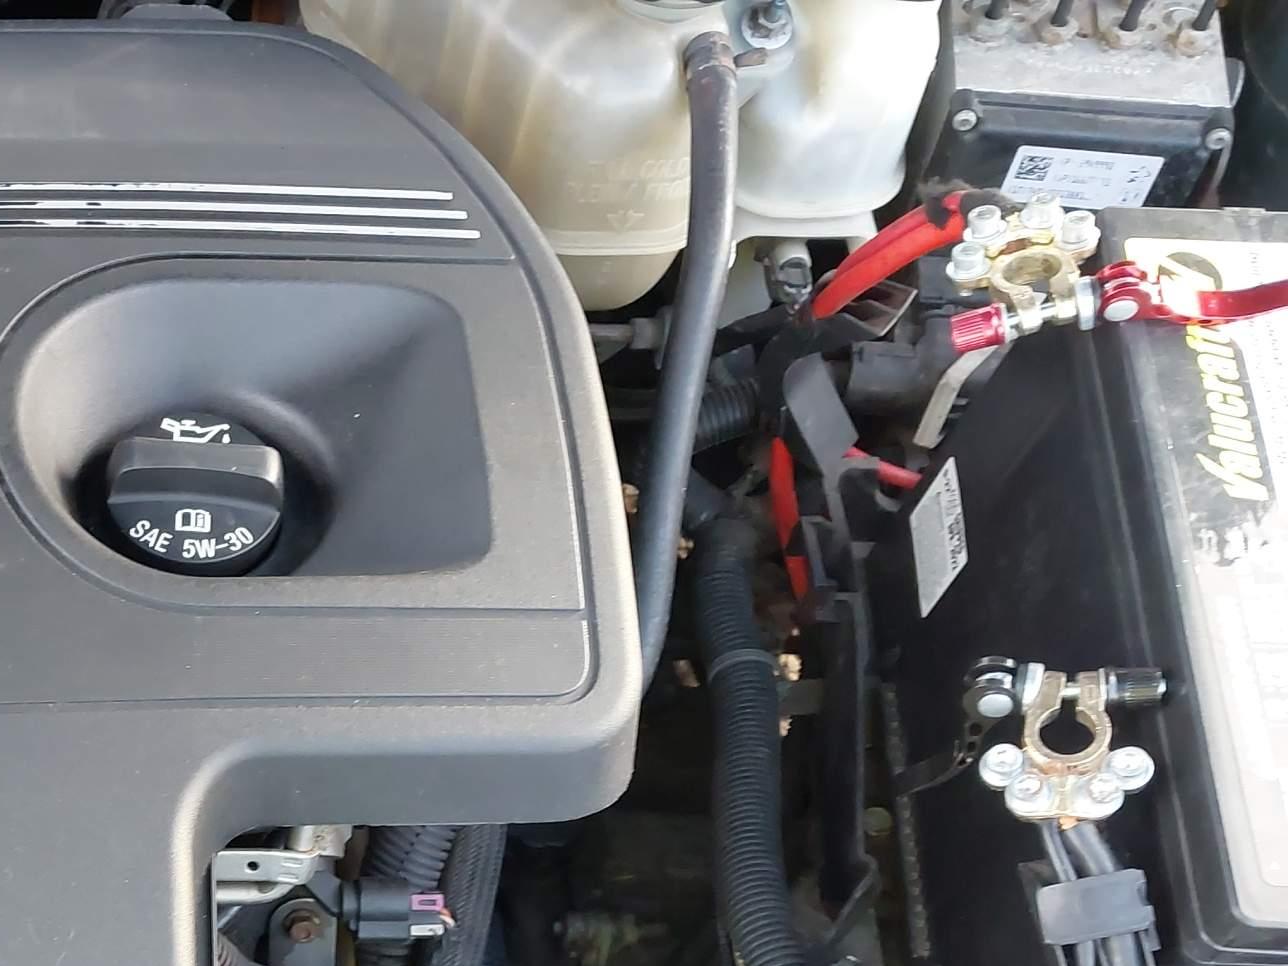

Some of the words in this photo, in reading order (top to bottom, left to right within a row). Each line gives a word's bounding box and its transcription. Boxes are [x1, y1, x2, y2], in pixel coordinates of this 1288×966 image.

[1185, 325, 1269, 501] Valucraft
[129, 520, 174, 552] SAE
[182, 527, 255, 558] 5W-30
